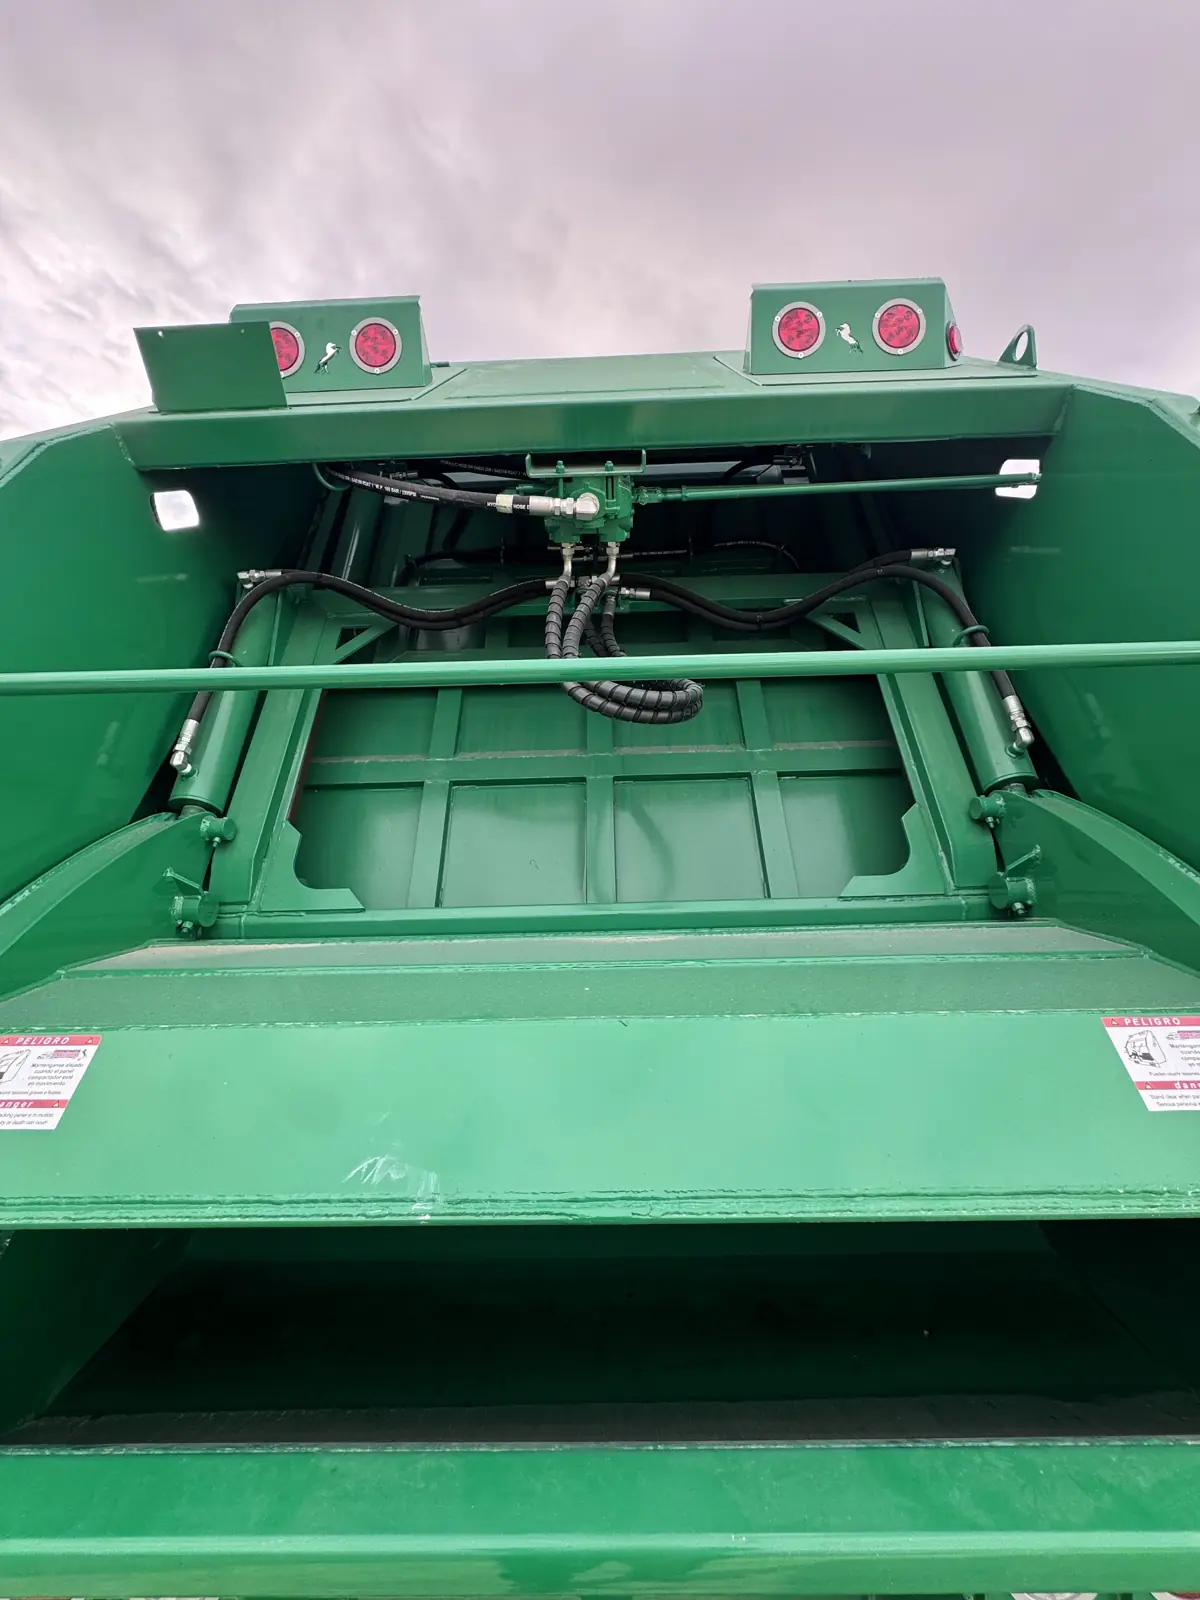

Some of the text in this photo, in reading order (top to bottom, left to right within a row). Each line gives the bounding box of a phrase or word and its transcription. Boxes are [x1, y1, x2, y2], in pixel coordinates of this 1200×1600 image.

[1123, 1018, 1181, 1026] PELIGRO
[15, 1036, 70, 1045] PELIGRO
[0, 1101, 34, 1109] anger
